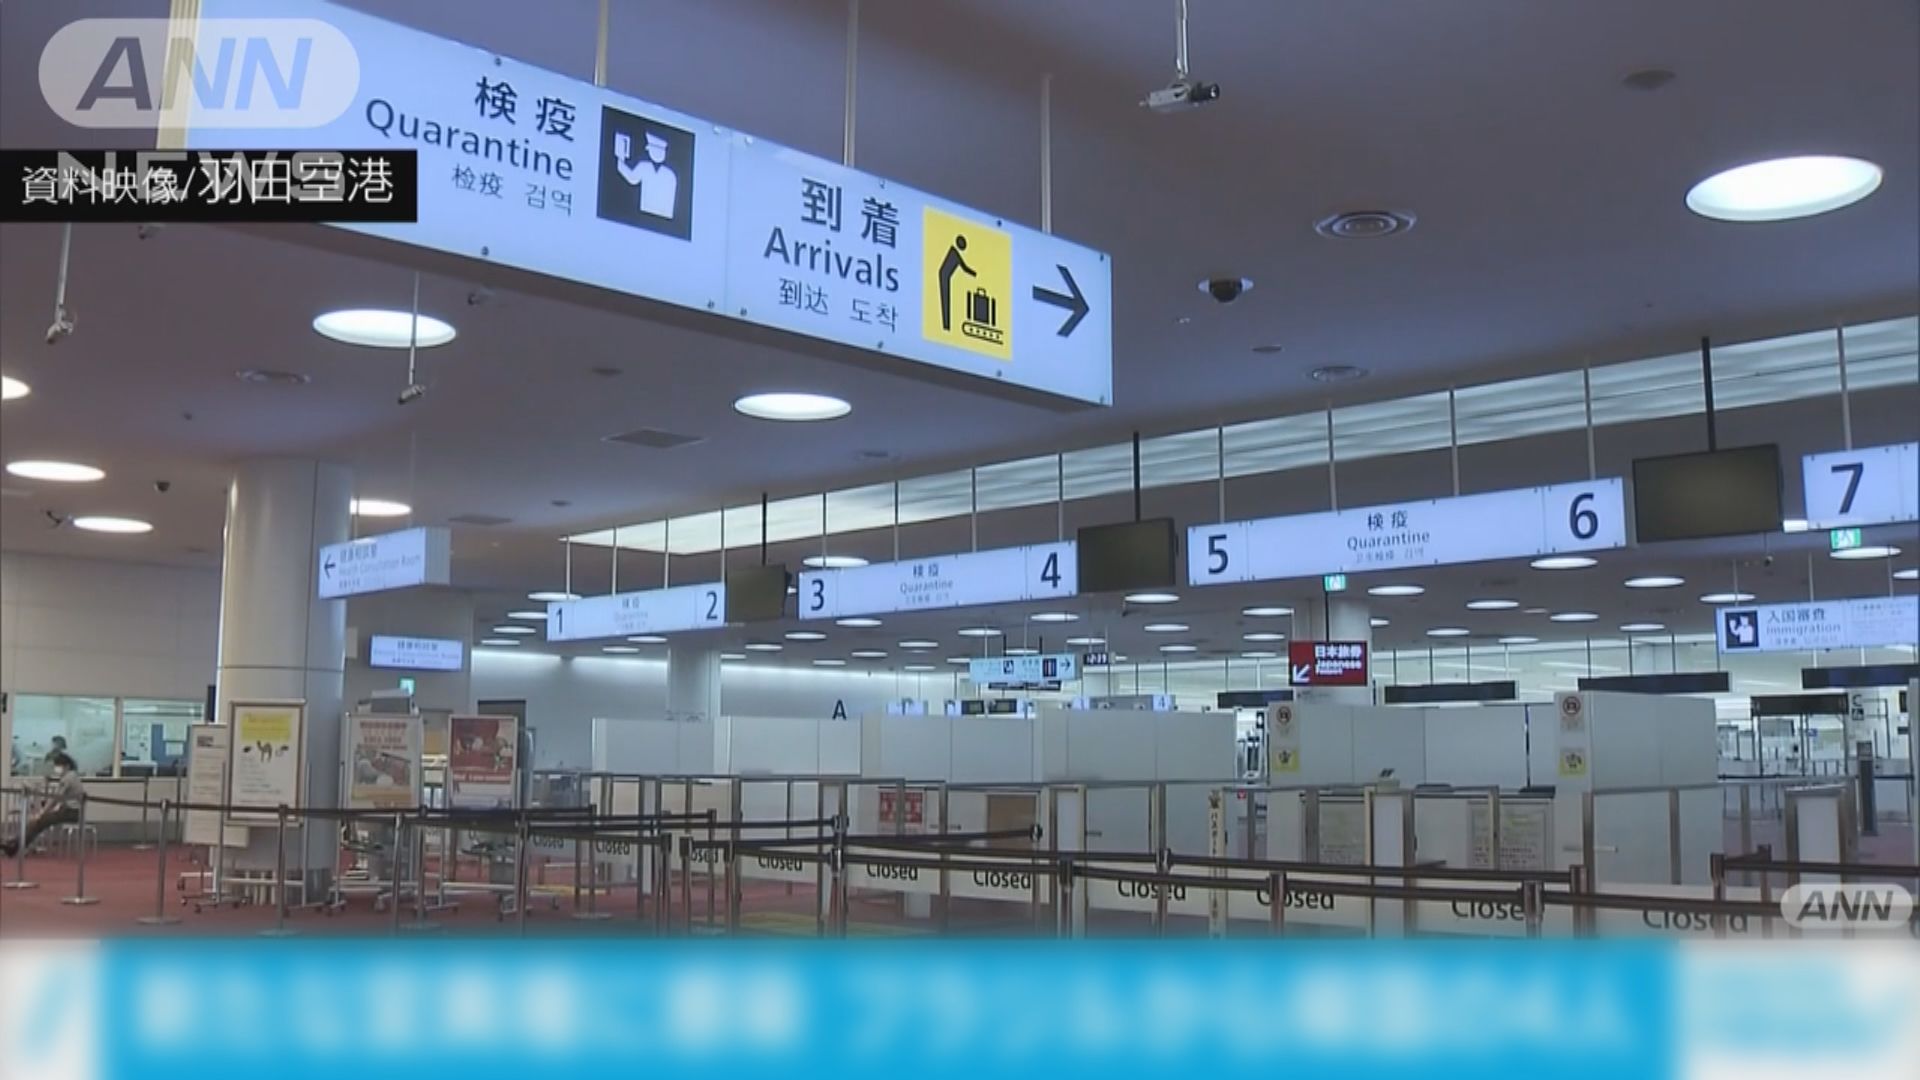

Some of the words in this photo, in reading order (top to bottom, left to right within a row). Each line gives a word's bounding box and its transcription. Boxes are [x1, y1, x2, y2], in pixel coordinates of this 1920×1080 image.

[474, 76, 577, 142] 検疫
[365, 97, 574, 181] Quarantine
[800, 177, 901, 250] 到着
[763, 226, 900, 292] Arrivals
[778, 277, 829, 316] 到达
[1830, 461, 1864, 515] 7
[1568, 492, 1599, 540] 6
[1207, 533, 1229, 575] 5
[1347, 531, 1430, 551] Quarantine
[899, 579, 954, 595] Quarantine
[1040, 551, 1062, 589] 4
[705, 590, 718, 621] 2
[810, 578, 826, 612] 3
[555, 607, 563, 634] 1
[832, 699, 847, 720] A
[757, 855, 803, 872] Closed
[866, 862, 919, 881] Closed
[972, 868, 1032, 890] Closed
[1451, 899, 1525, 921] Close
